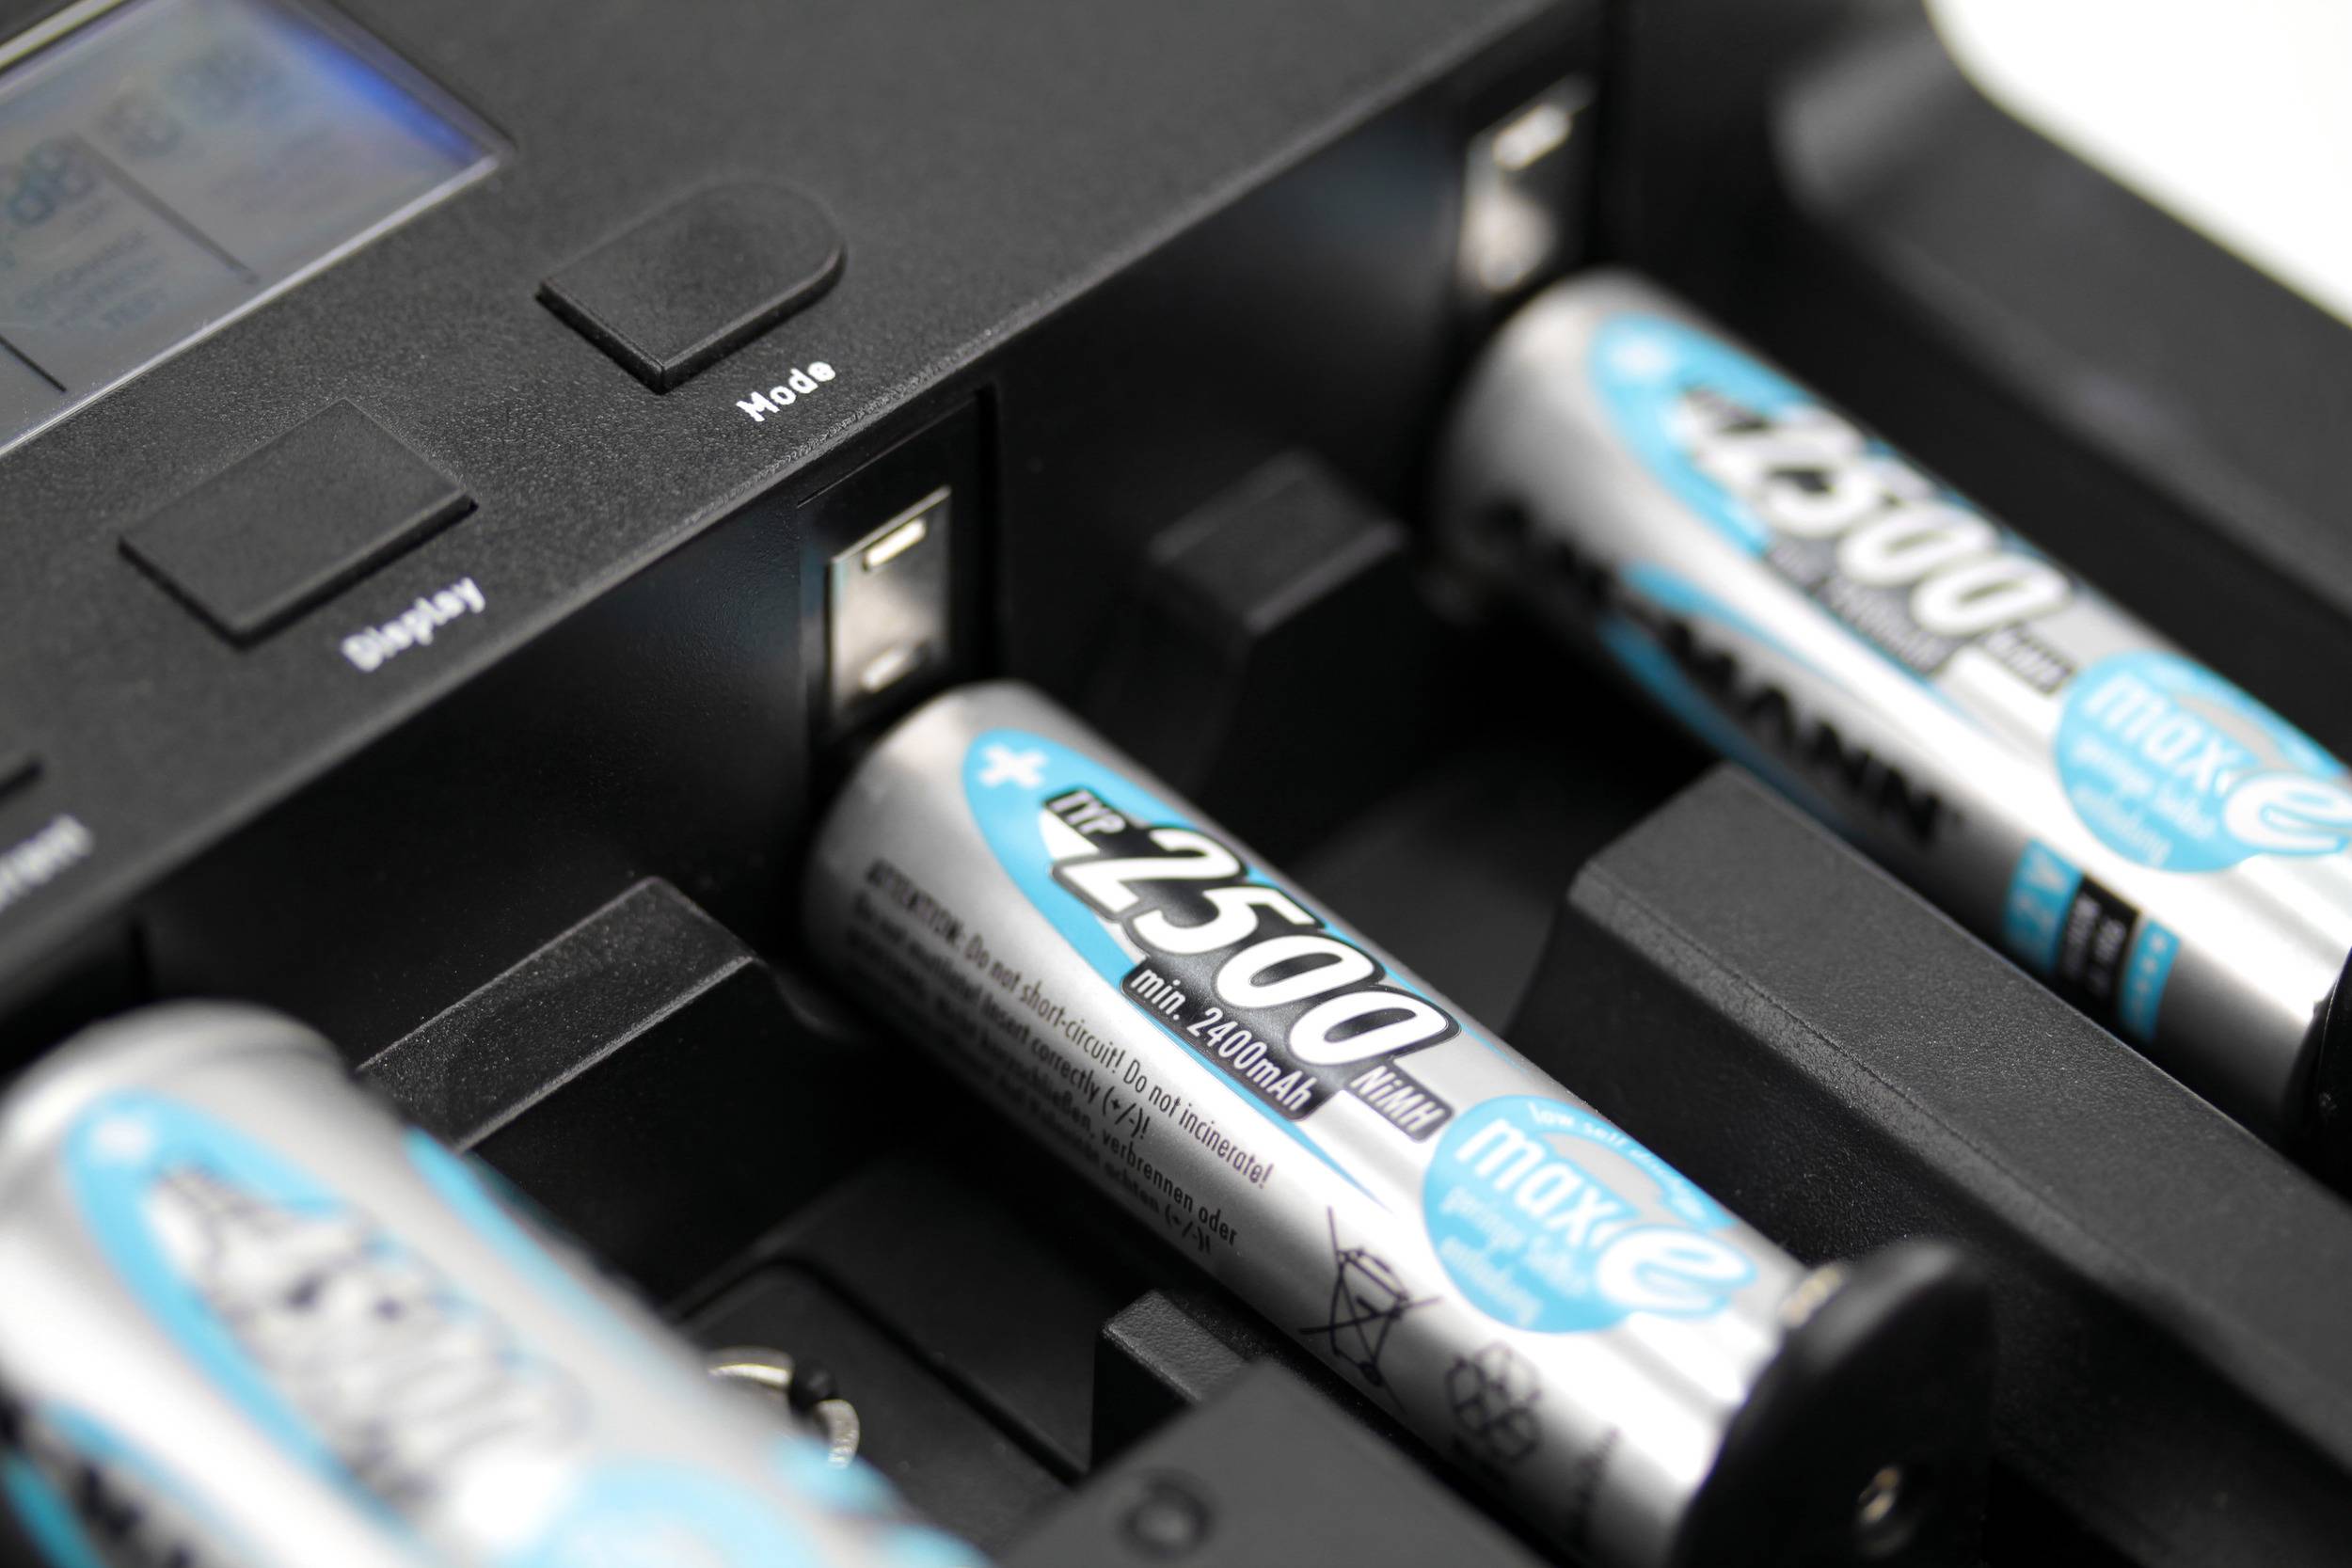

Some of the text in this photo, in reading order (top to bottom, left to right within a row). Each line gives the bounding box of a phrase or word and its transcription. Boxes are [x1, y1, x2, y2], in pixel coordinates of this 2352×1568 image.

[736, 361, 835, 421] Mode
[341, 578, 485, 672] Display
[1047, 789, 1125, 834] TYP
[1057, 829, 1448, 1066] 2500
[963, 933, 991, 969] Do
[987, 961, 1022, 991] not
[1020, 980, 1125, 1073] short-circuit!
[1121, 1058, 1148, 1092] Do
[1148, 1085, 1180, 1117] not
[1177, 1101, 1272, 1189] incinerate!
[1031, 1038, 1096, 1102] correctly
[1104, 1085, 1150, 1138] (+/-)!
[1130, 968, 1316, 1112] min. 2400mAh
[1349, 1066, 1446, 1136] NiMH
[1101, 1130, 1192, 1212] verbrennen
[1196, 1207, 1235, 1244] oder
